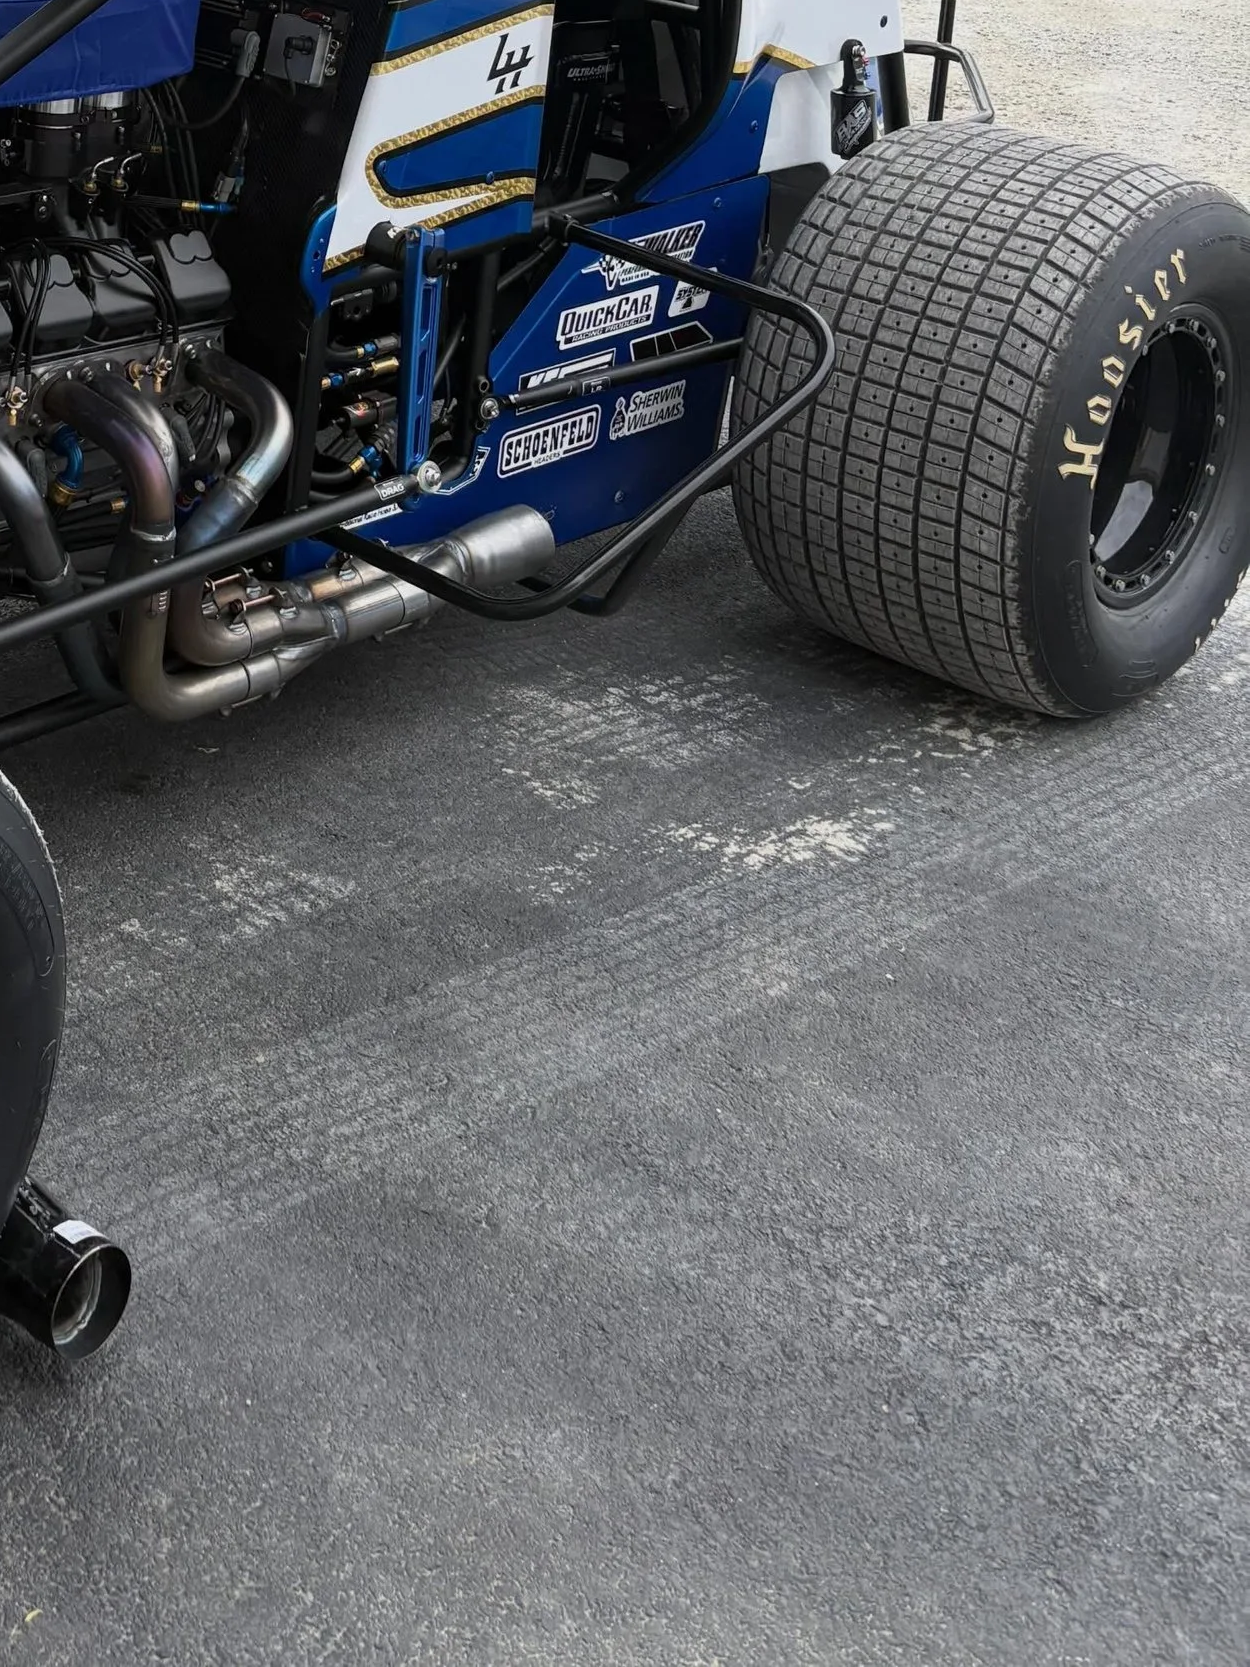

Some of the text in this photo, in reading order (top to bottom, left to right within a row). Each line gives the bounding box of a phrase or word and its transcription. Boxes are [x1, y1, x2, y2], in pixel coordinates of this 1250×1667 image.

[572, 315, 648, 343] RACING PRODUCTS
[1057, 248, 1187, 491] Hoosier
[630, 384, 684, 414] SHERWIN
[627, 406, 683, 433] WILLIAMS
[504, 413, 594, 468] SCHOENFELD
[533, 451, 561, 466] HEADERS
[381, 482, 405, 499] DRAG
